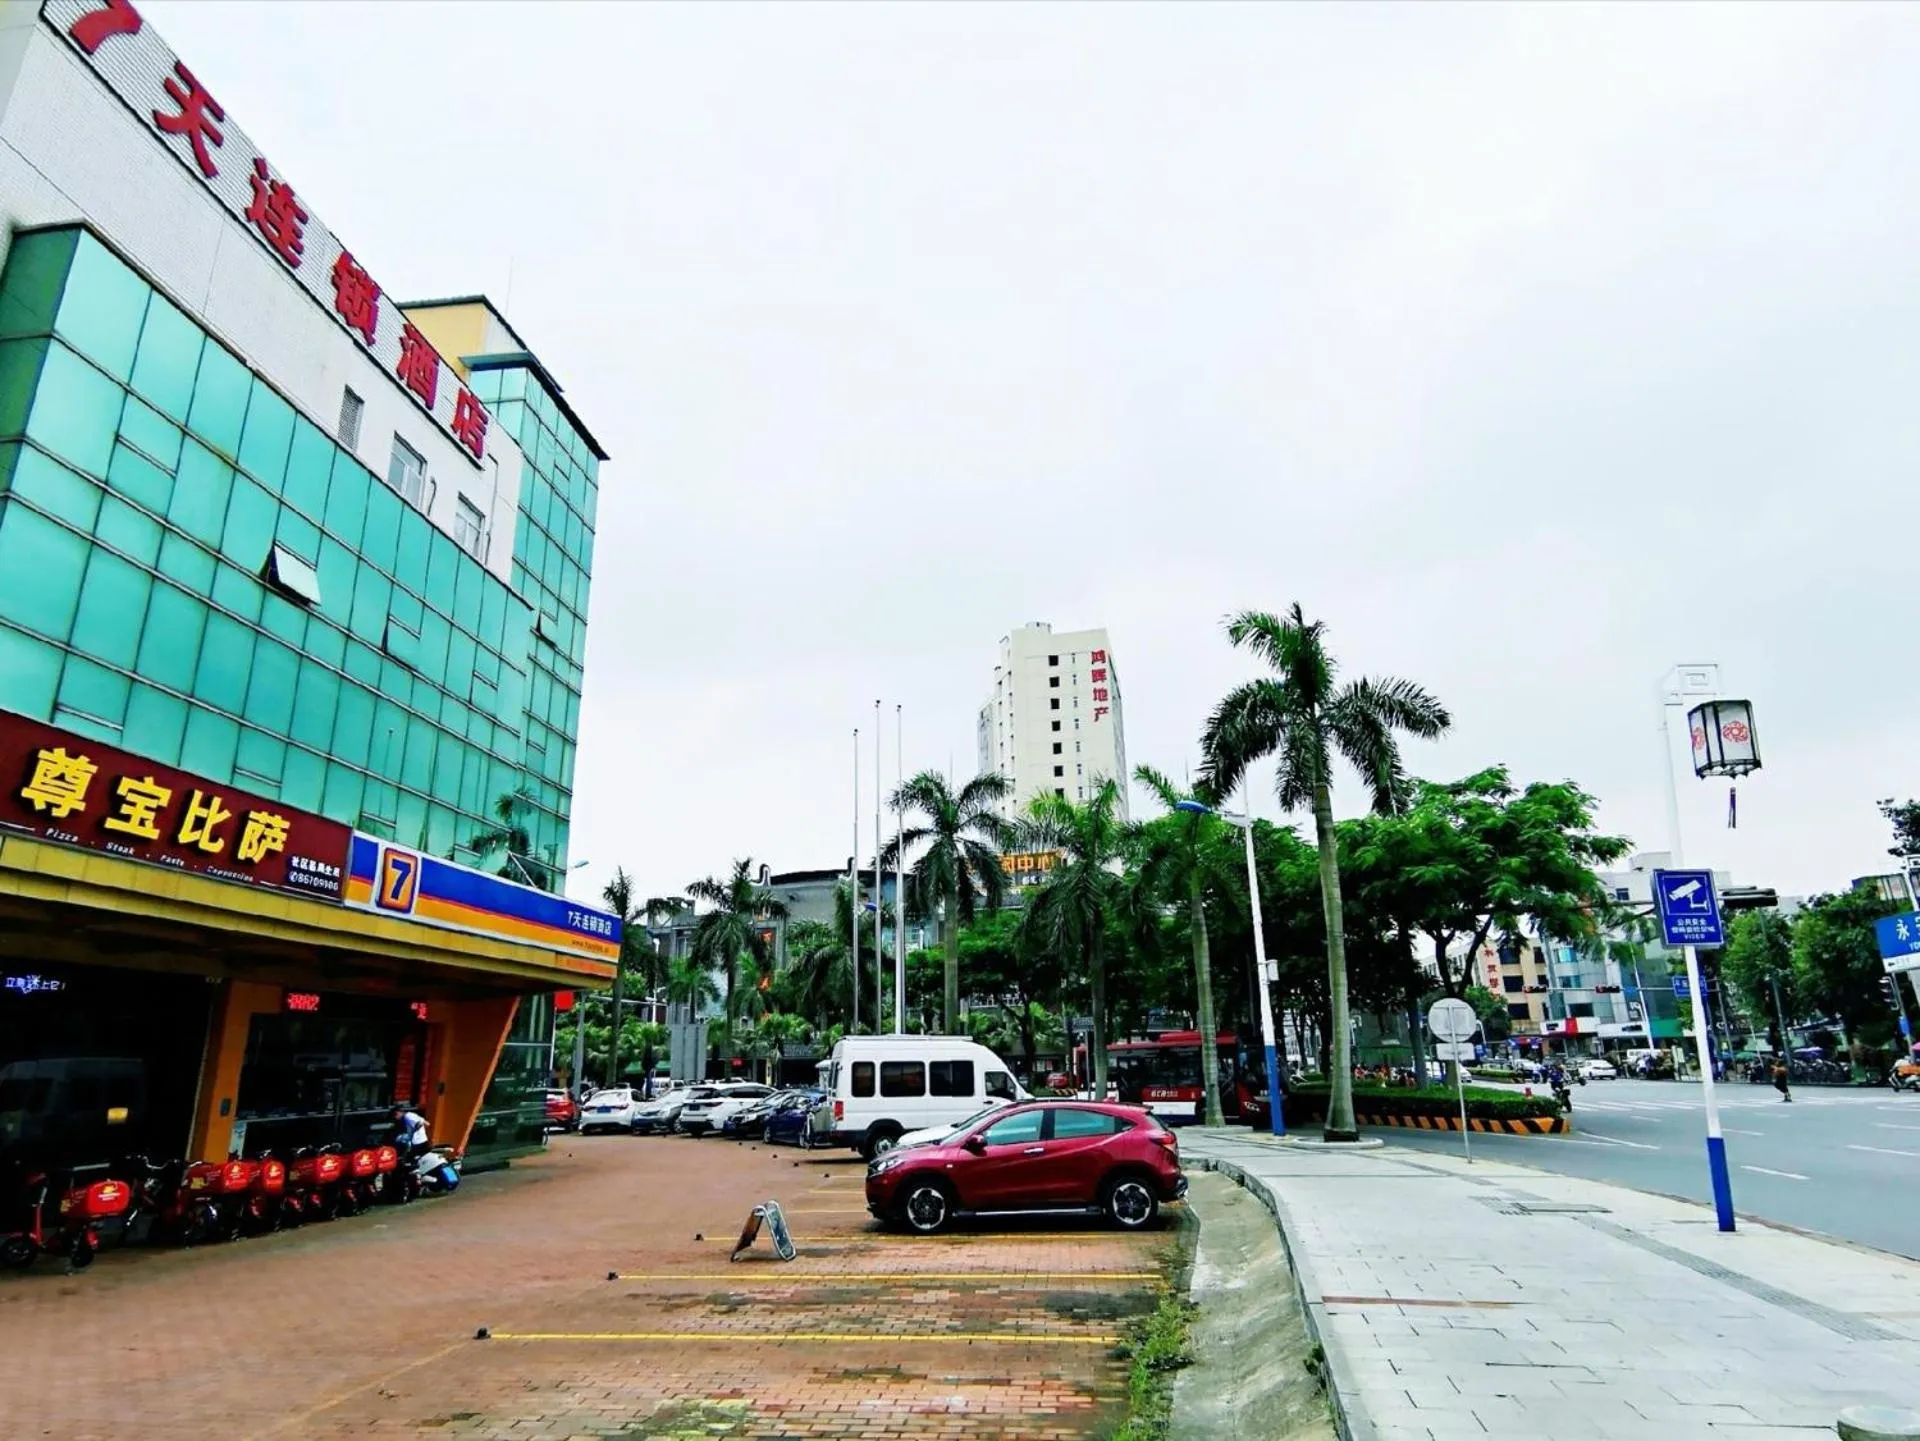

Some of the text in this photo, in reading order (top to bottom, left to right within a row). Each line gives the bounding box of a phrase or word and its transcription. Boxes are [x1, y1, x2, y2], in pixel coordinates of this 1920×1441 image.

[21, 747, 291, 864] 尊宝比萨
[46, 827, 79, 842] Pizza
[391, 858, 412, 900] 7
